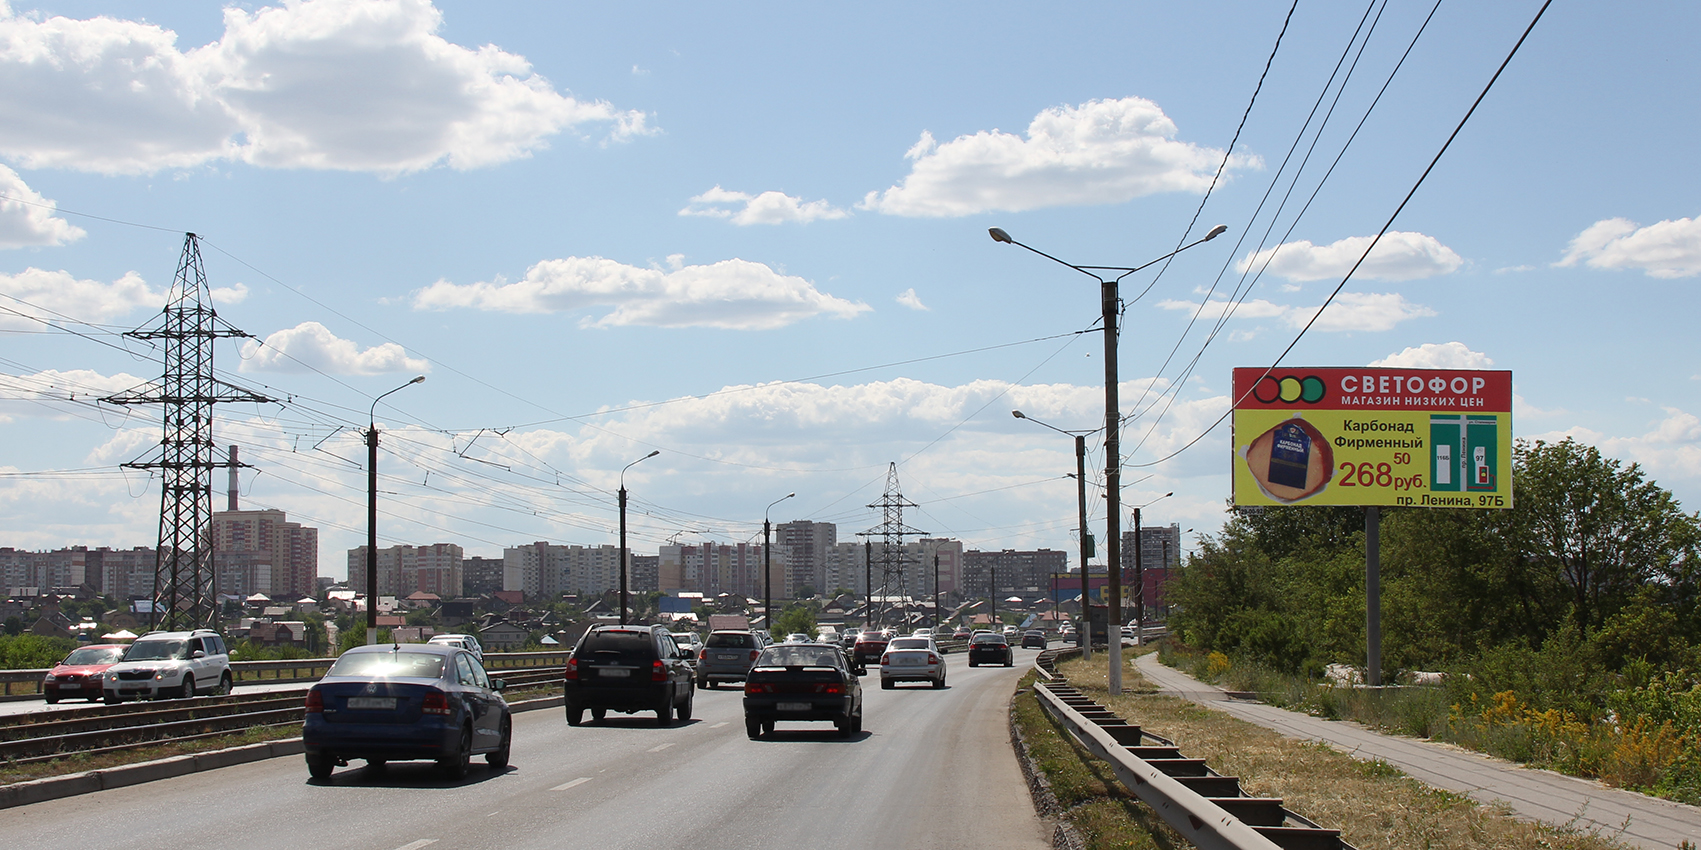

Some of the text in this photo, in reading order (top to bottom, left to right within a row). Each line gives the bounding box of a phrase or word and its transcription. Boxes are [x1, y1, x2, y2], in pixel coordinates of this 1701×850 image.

[1341, 375, 1485, 394] СВЕТОФОР
[1341, 397, 1484, 407] МАГАЗИН НИЗКИХ ЦЕН
[1343, 420, 1414, 434] Карбонад
[1334, 436, 1423, 449] Фирменный
[1338, 452, 1411, 487] 268 50
[1395, 474, 1427, 491] руб.
[1396, 495, 1504, 508] пр. Ленина, 97Б
